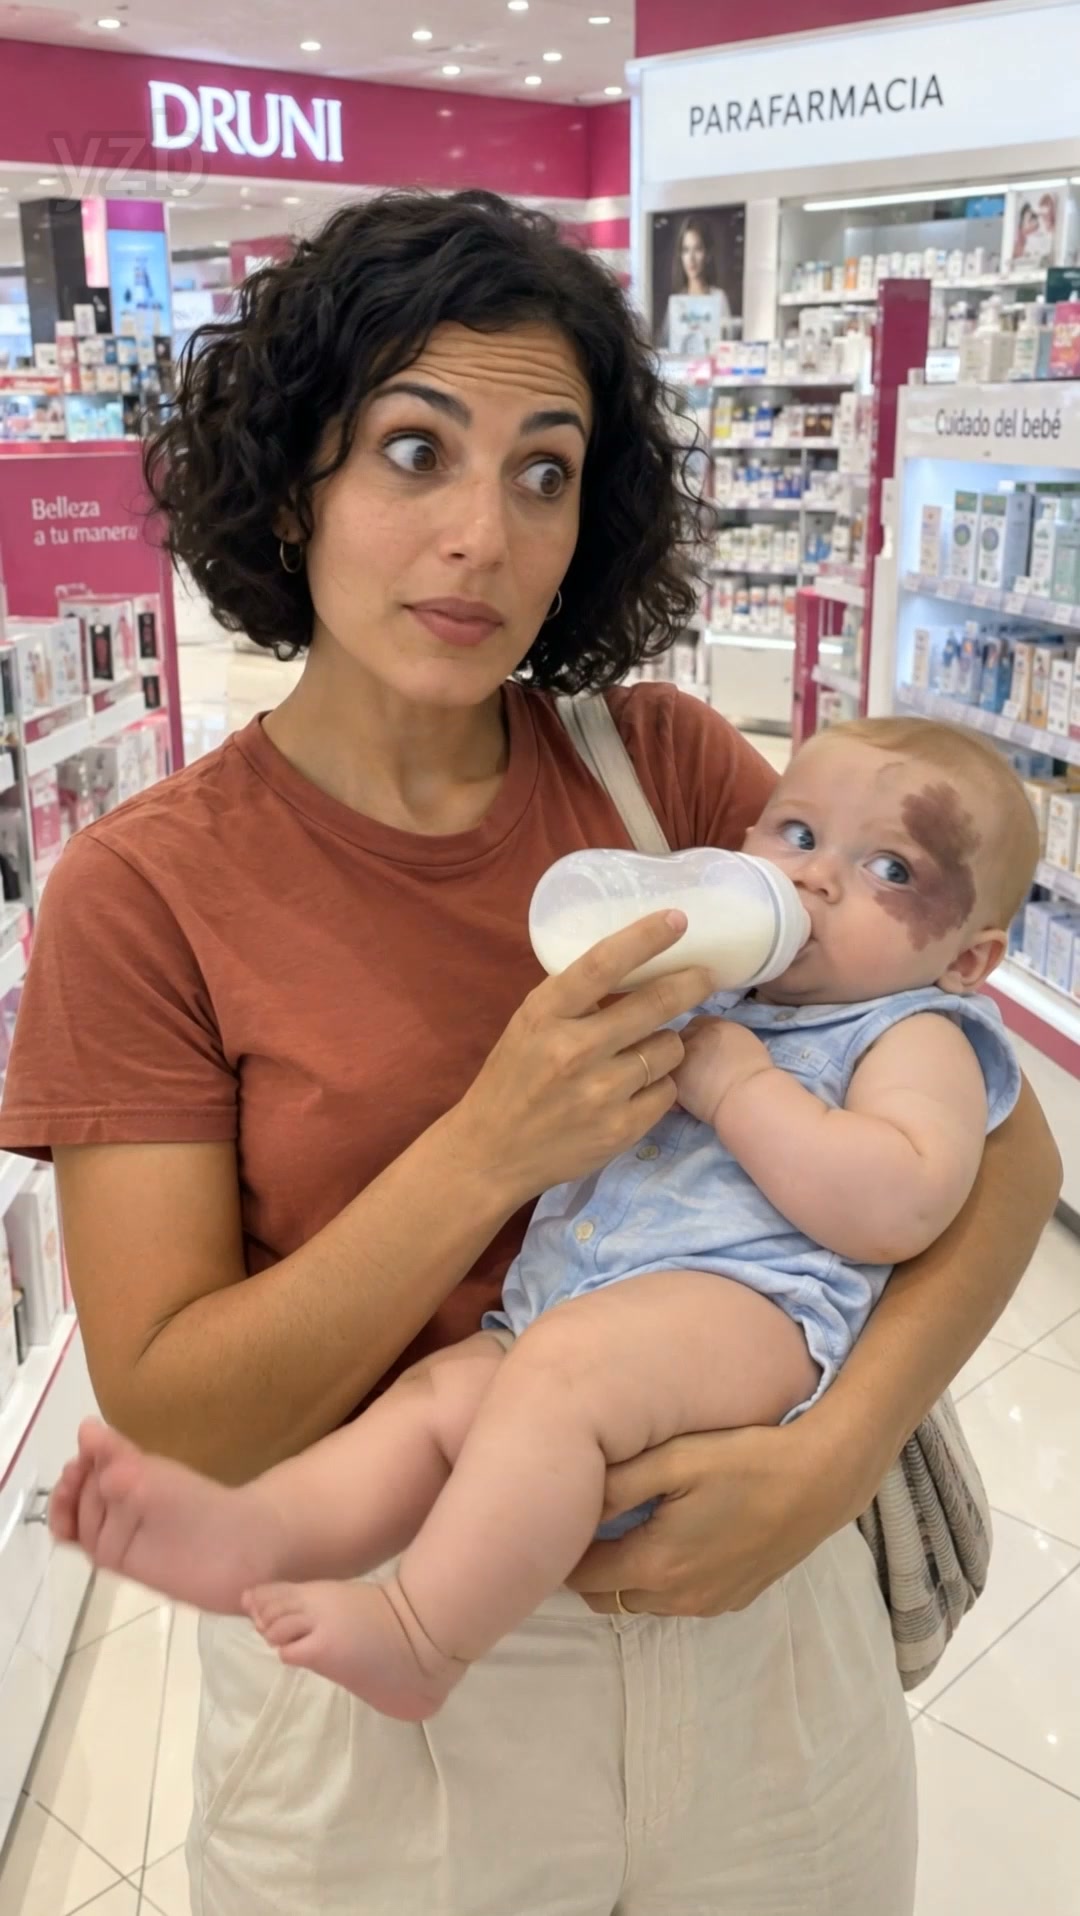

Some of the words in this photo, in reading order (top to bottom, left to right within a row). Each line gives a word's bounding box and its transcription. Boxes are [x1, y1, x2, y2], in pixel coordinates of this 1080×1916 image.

[689, 73, 944, 136] PARAFARMACIA
[148, 80, 343, 162] DRUNI
[935, 408, 990, 437] Cuidado
[994, 408, 1018, 438] del
[1021, 407, 1061, 439] bebé
[31, 495, 101, 520] Belleza
[33, 529, 46, 546] a
[49, 526, 69, 545] tu
